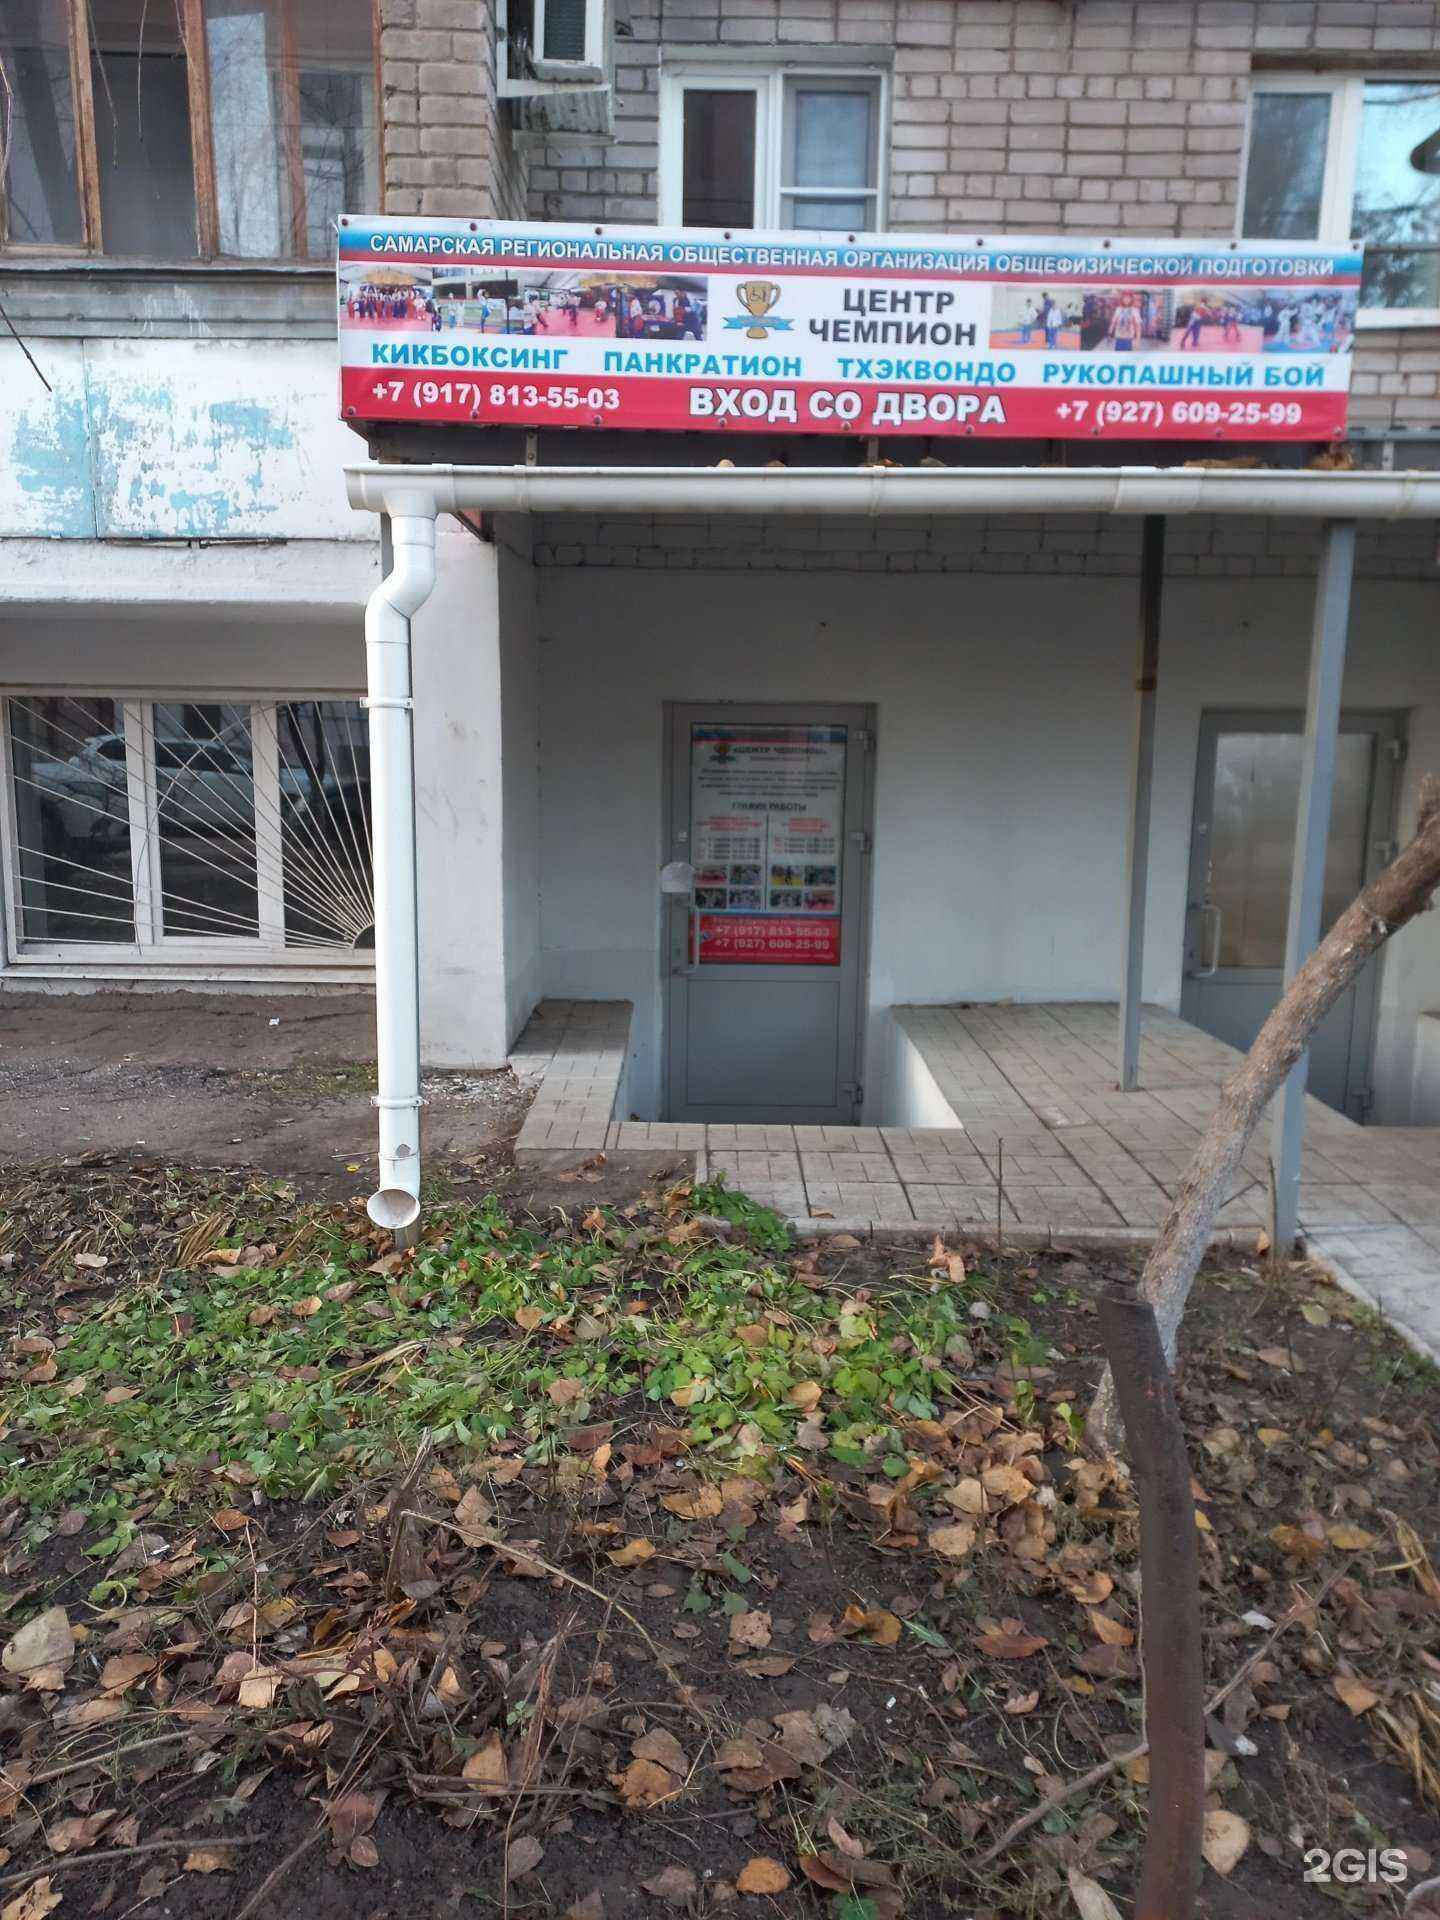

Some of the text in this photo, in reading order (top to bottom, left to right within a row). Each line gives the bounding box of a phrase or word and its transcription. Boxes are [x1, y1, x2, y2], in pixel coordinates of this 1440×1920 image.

[369, 234, 1334, 278] САМАРСКАЯ РЕГИОНАЛЬНАЯ ОБЩЕСТВЕННАЯ ОРГАНИЗАЦИЯ ОБЩЕФИЗИЧЕСКОЙ ПОДГОТОВКИ
[843, 289, 955, 316] ЦЕНТР
[809, 318, 977, 347] ЧЕМПИОН
[371, 342, 568, 371] КИКБОКСИНГ
[604, 350, 802, 378] ПАНКРАТИОН
[838, 356, 1016, 386] ТХЭКВОНДО
[1042, 359, 1325, 387] РУКОПАШНЫЙ БОЙ
[372, 381, 621, 410] +7 (917) 813-55-03
[689, 388, 1007, 426] ВХОД СО ДВОРА
[1056, 399, 1303, 427] +7 (927) 609-25-99
